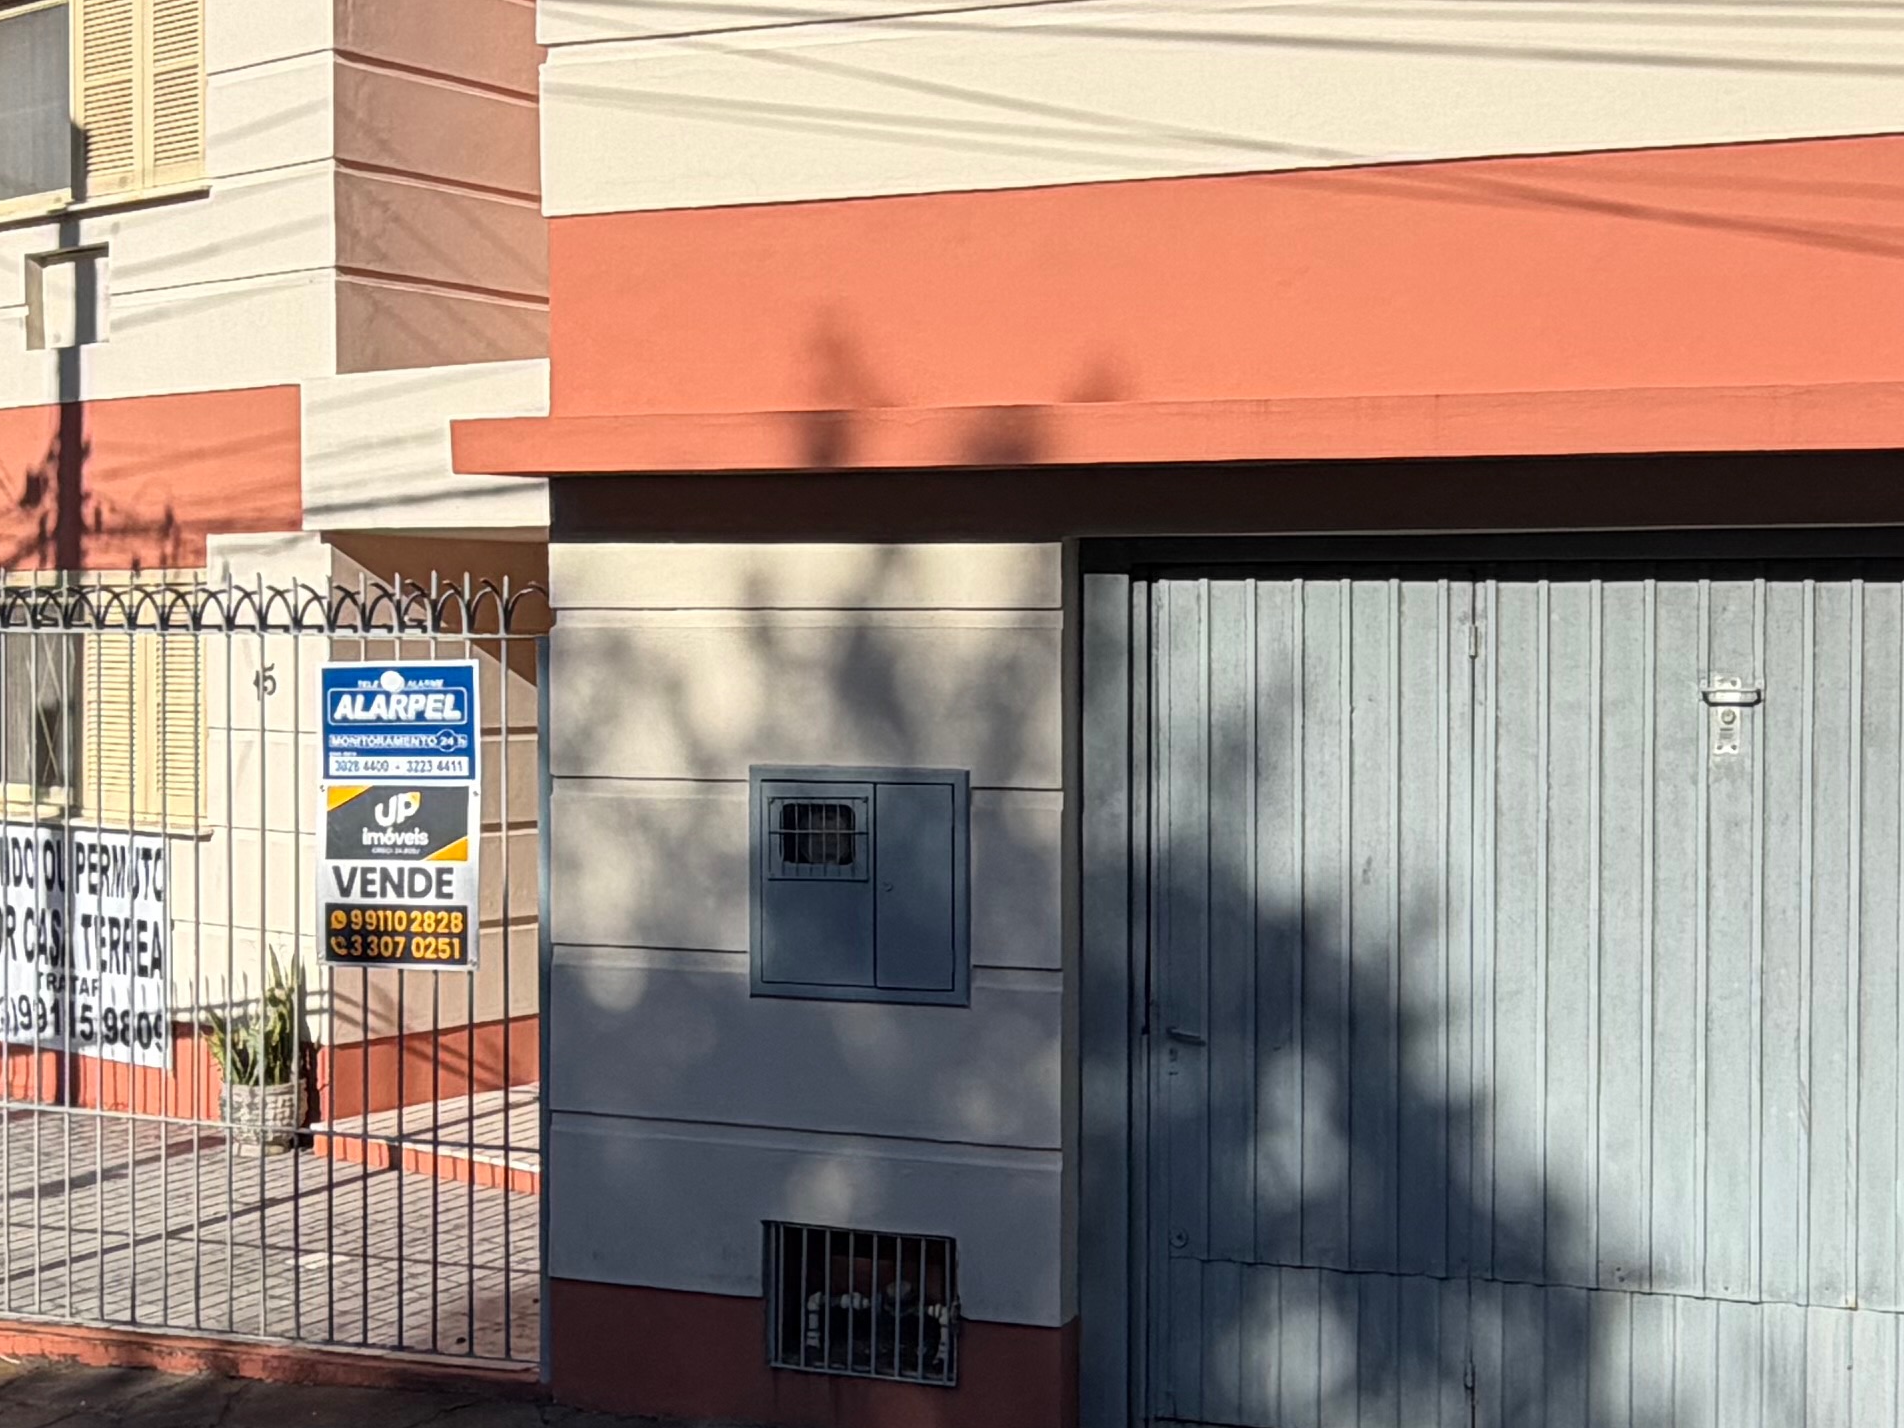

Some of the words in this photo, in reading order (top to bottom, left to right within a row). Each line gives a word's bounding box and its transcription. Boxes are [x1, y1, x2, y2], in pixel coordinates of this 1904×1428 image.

[334, 694, 462, 720] ALARPEL
[331, 736, 437, 747] MONITORAMENTO
[374, 791, 421, 827] UP
[362, 826, 429, 846] imóveis
[75, 841, 166, 902] PERMUTO
[332, 865, 454, 899] VENDE
[411, 937, 460, 960] 0251
